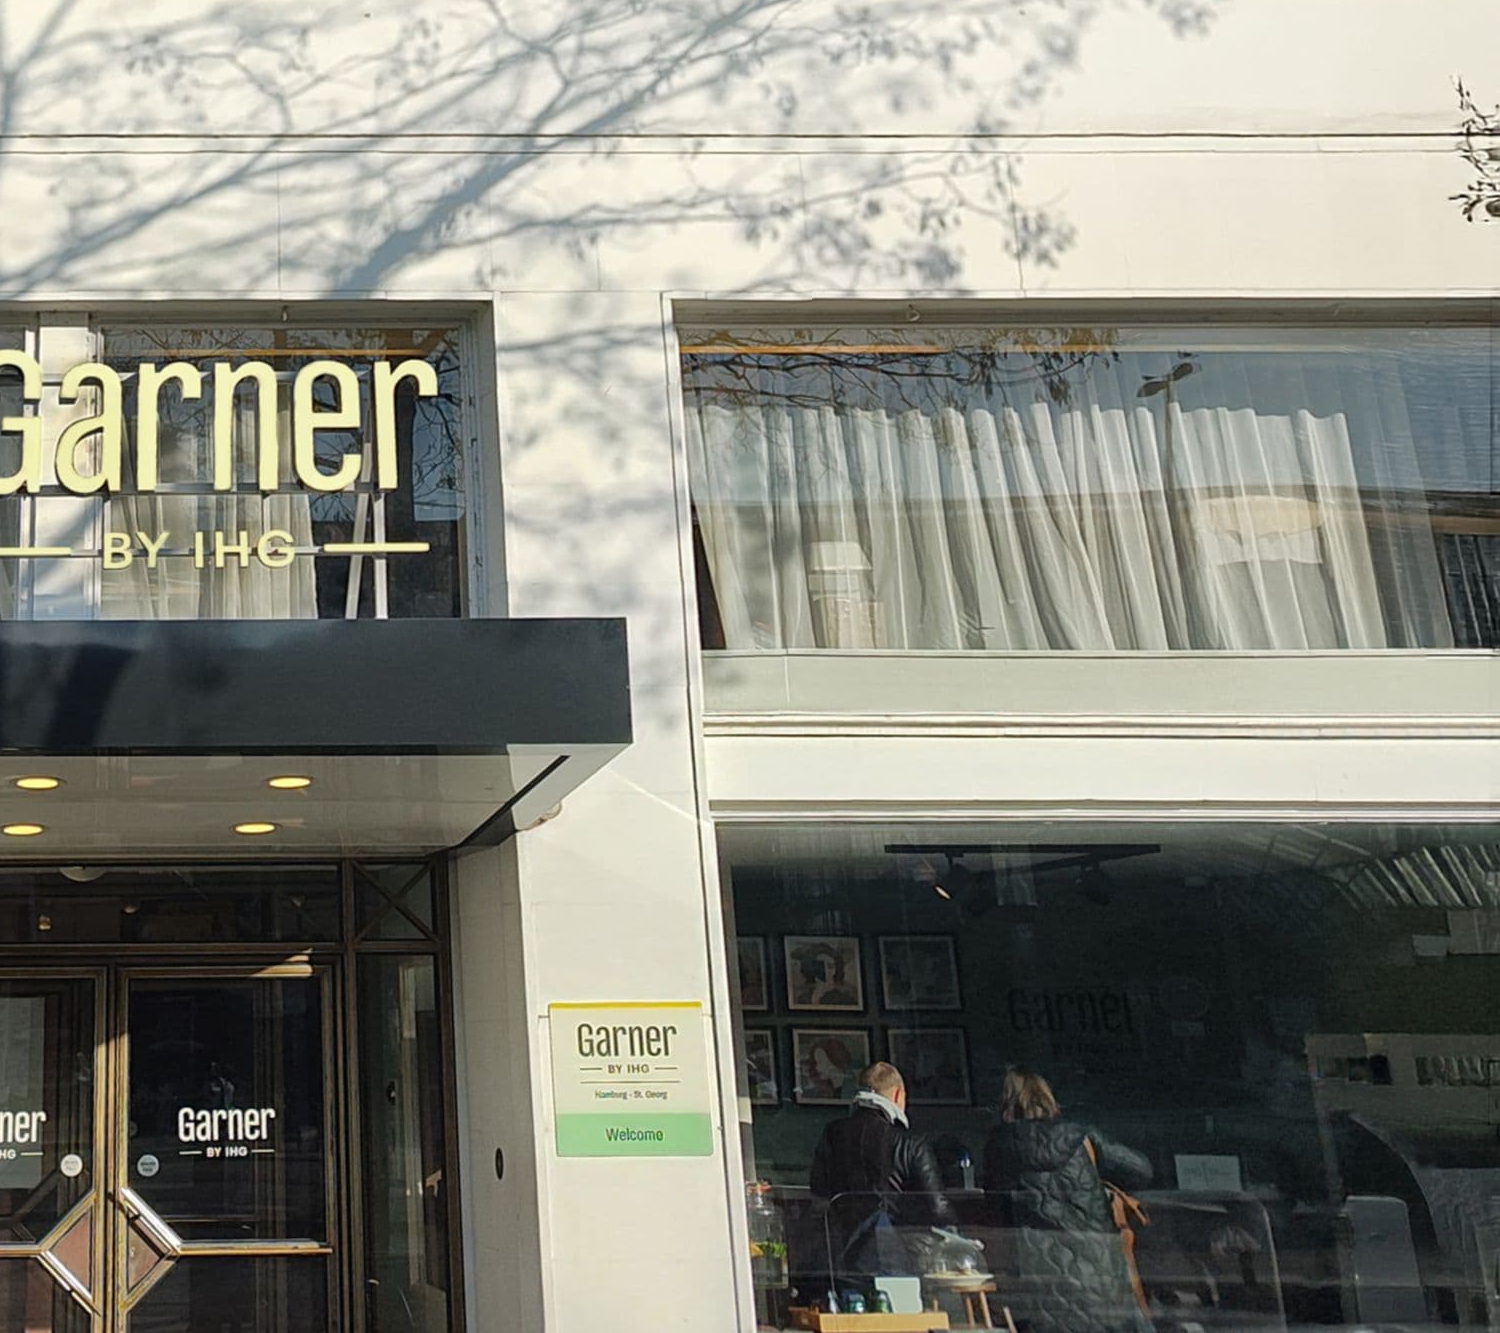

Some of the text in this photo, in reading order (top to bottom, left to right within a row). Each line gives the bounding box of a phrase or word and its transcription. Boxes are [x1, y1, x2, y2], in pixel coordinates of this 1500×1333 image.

[102, 529, 298, 570] BY IHG
[577, 1023, 678, 1058] Garner
[607, 1063, 650, 1074] BY IHG
[178, 1107, 276, 1142] Garner
[605, 1127, 664, 1142] Welcome
[206, 1145, 248, 1158] BY IHG
